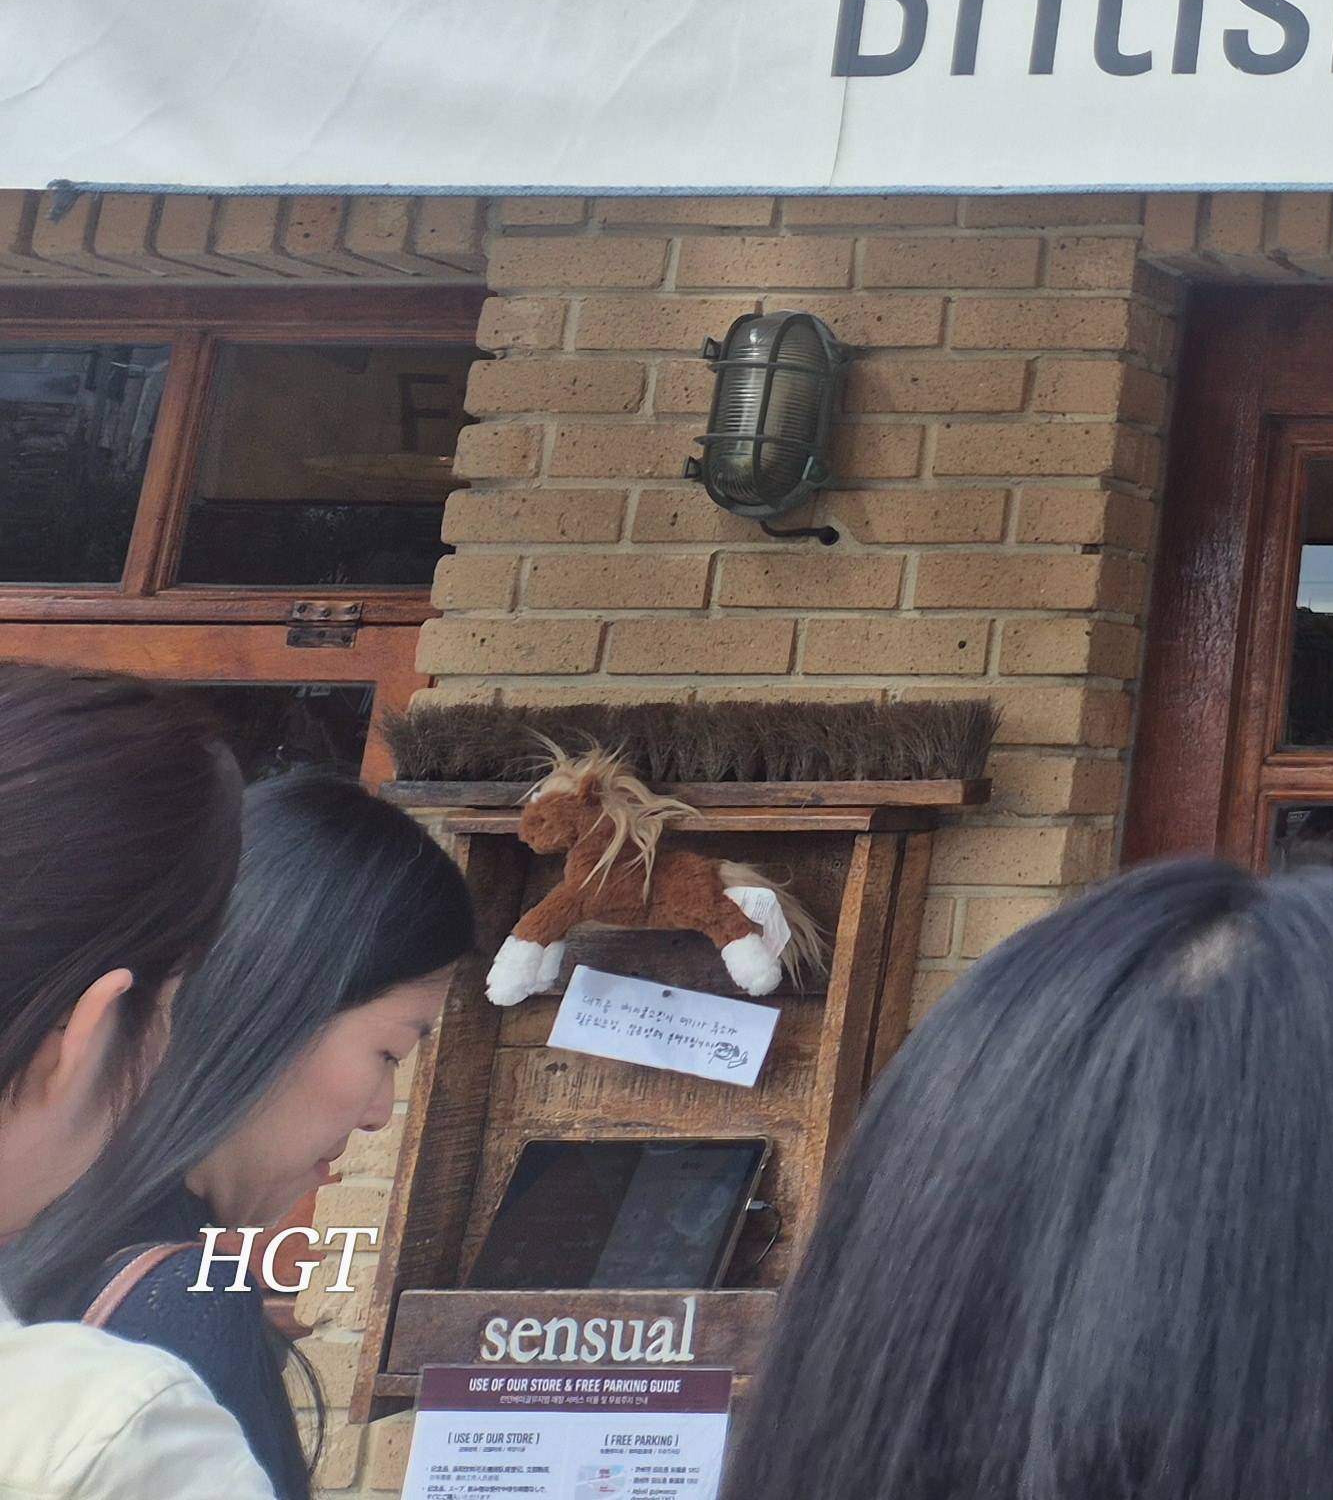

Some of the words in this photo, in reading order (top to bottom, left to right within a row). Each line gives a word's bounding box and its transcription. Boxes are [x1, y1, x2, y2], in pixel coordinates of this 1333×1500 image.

[479, 1296, 696, 1364] sensual
[469, 1378, 489, 1392] USE
[491, 1378, 505, 1392] OF
[506, 1378, 528, 1392] OUR
[530, 1378, 562, 1392] STORE
[564, 1379, 572, 1392] &
[575, 1378, 601, 1393] FREE
[603, 1379, 648, 1393] PARKING
[649, 1379, 681, 1393] GUIDE
[453, 1432, 471, 1444] USE
[472, 1432, 485, 1444] OF
[486, 1432, 504, 1444] OUR
[506, 1432, 534, 1444] STORE
[611, 1435, 634, 1446] FREE
[635, 1435, 672, 1446] PARKING
